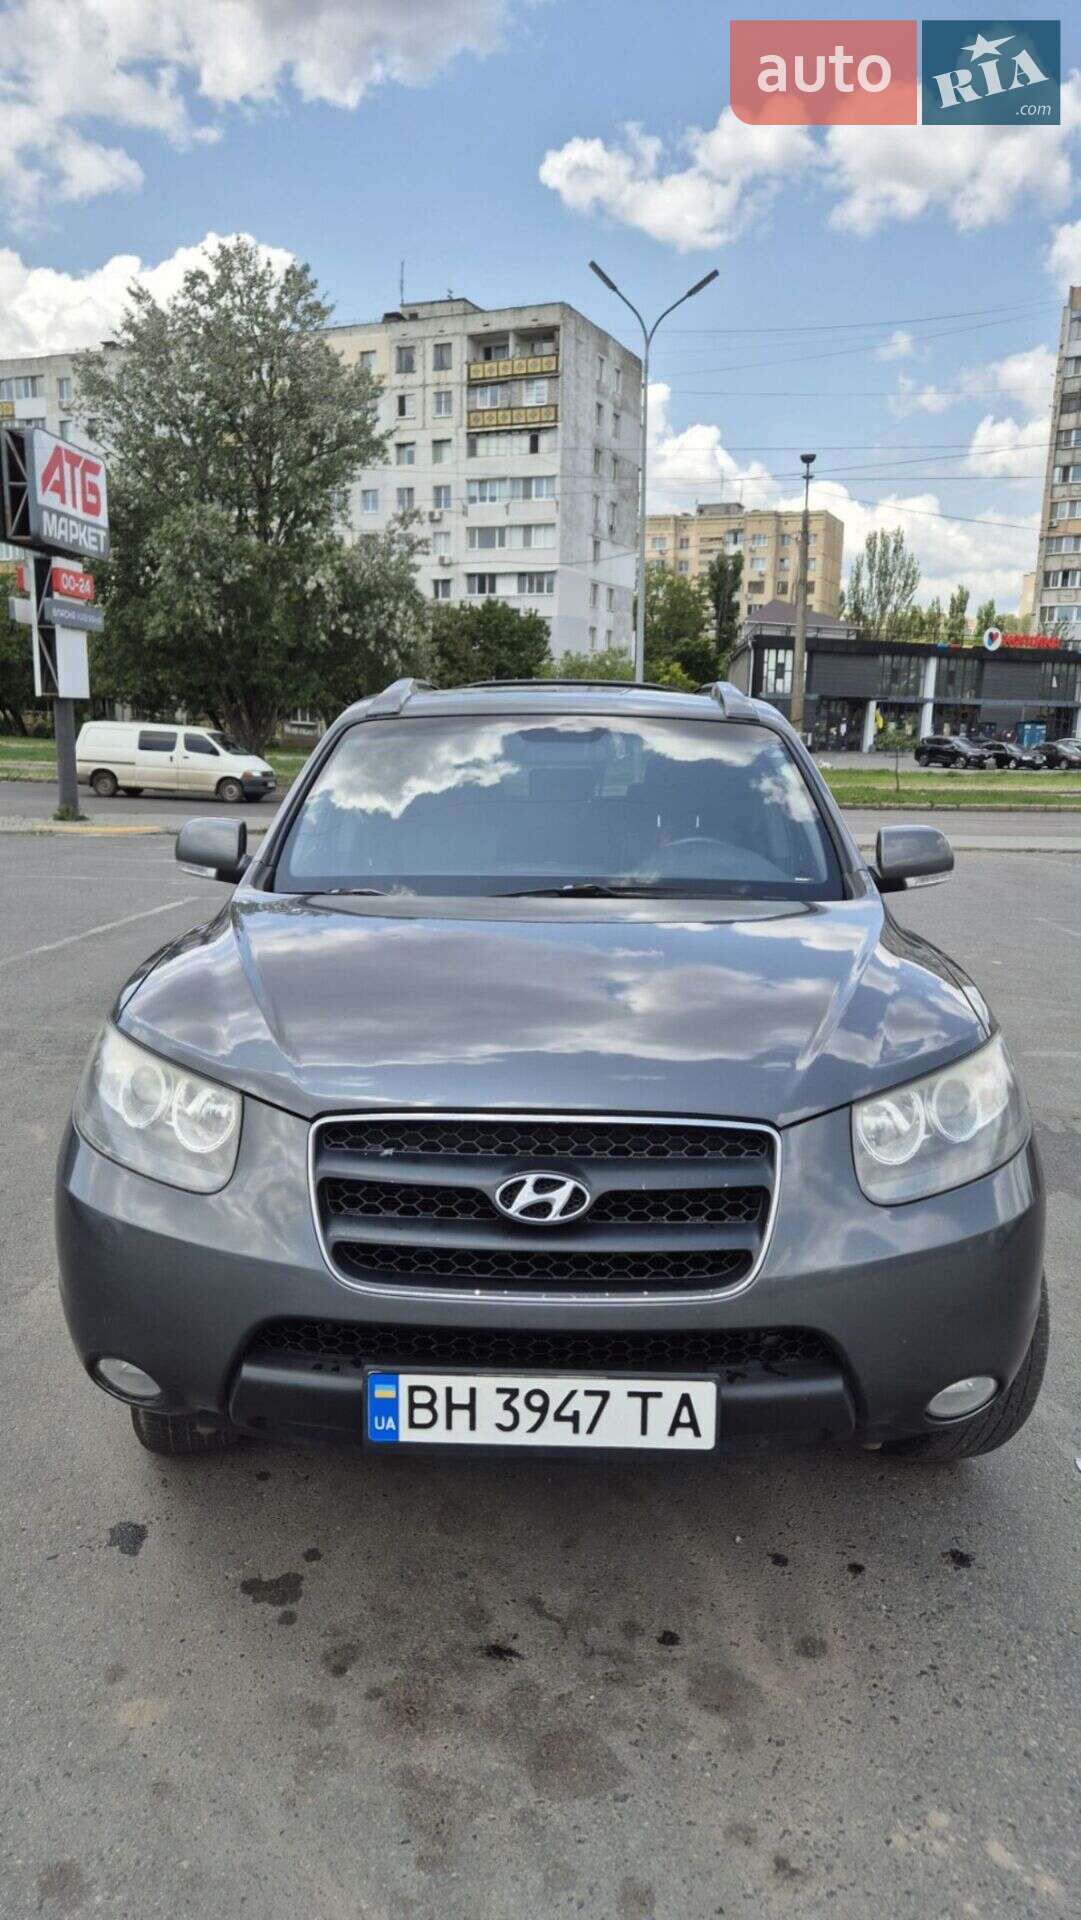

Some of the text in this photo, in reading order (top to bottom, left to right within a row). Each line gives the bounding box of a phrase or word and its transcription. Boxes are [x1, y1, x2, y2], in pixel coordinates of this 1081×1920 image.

[40, 445, 103, 517] АТБ
[43, 511, 107, 552] МАРКЕТ
[374, 1416, 396, 1431] UA
[407, 1385, 702, 1438] BH 3947 TA
